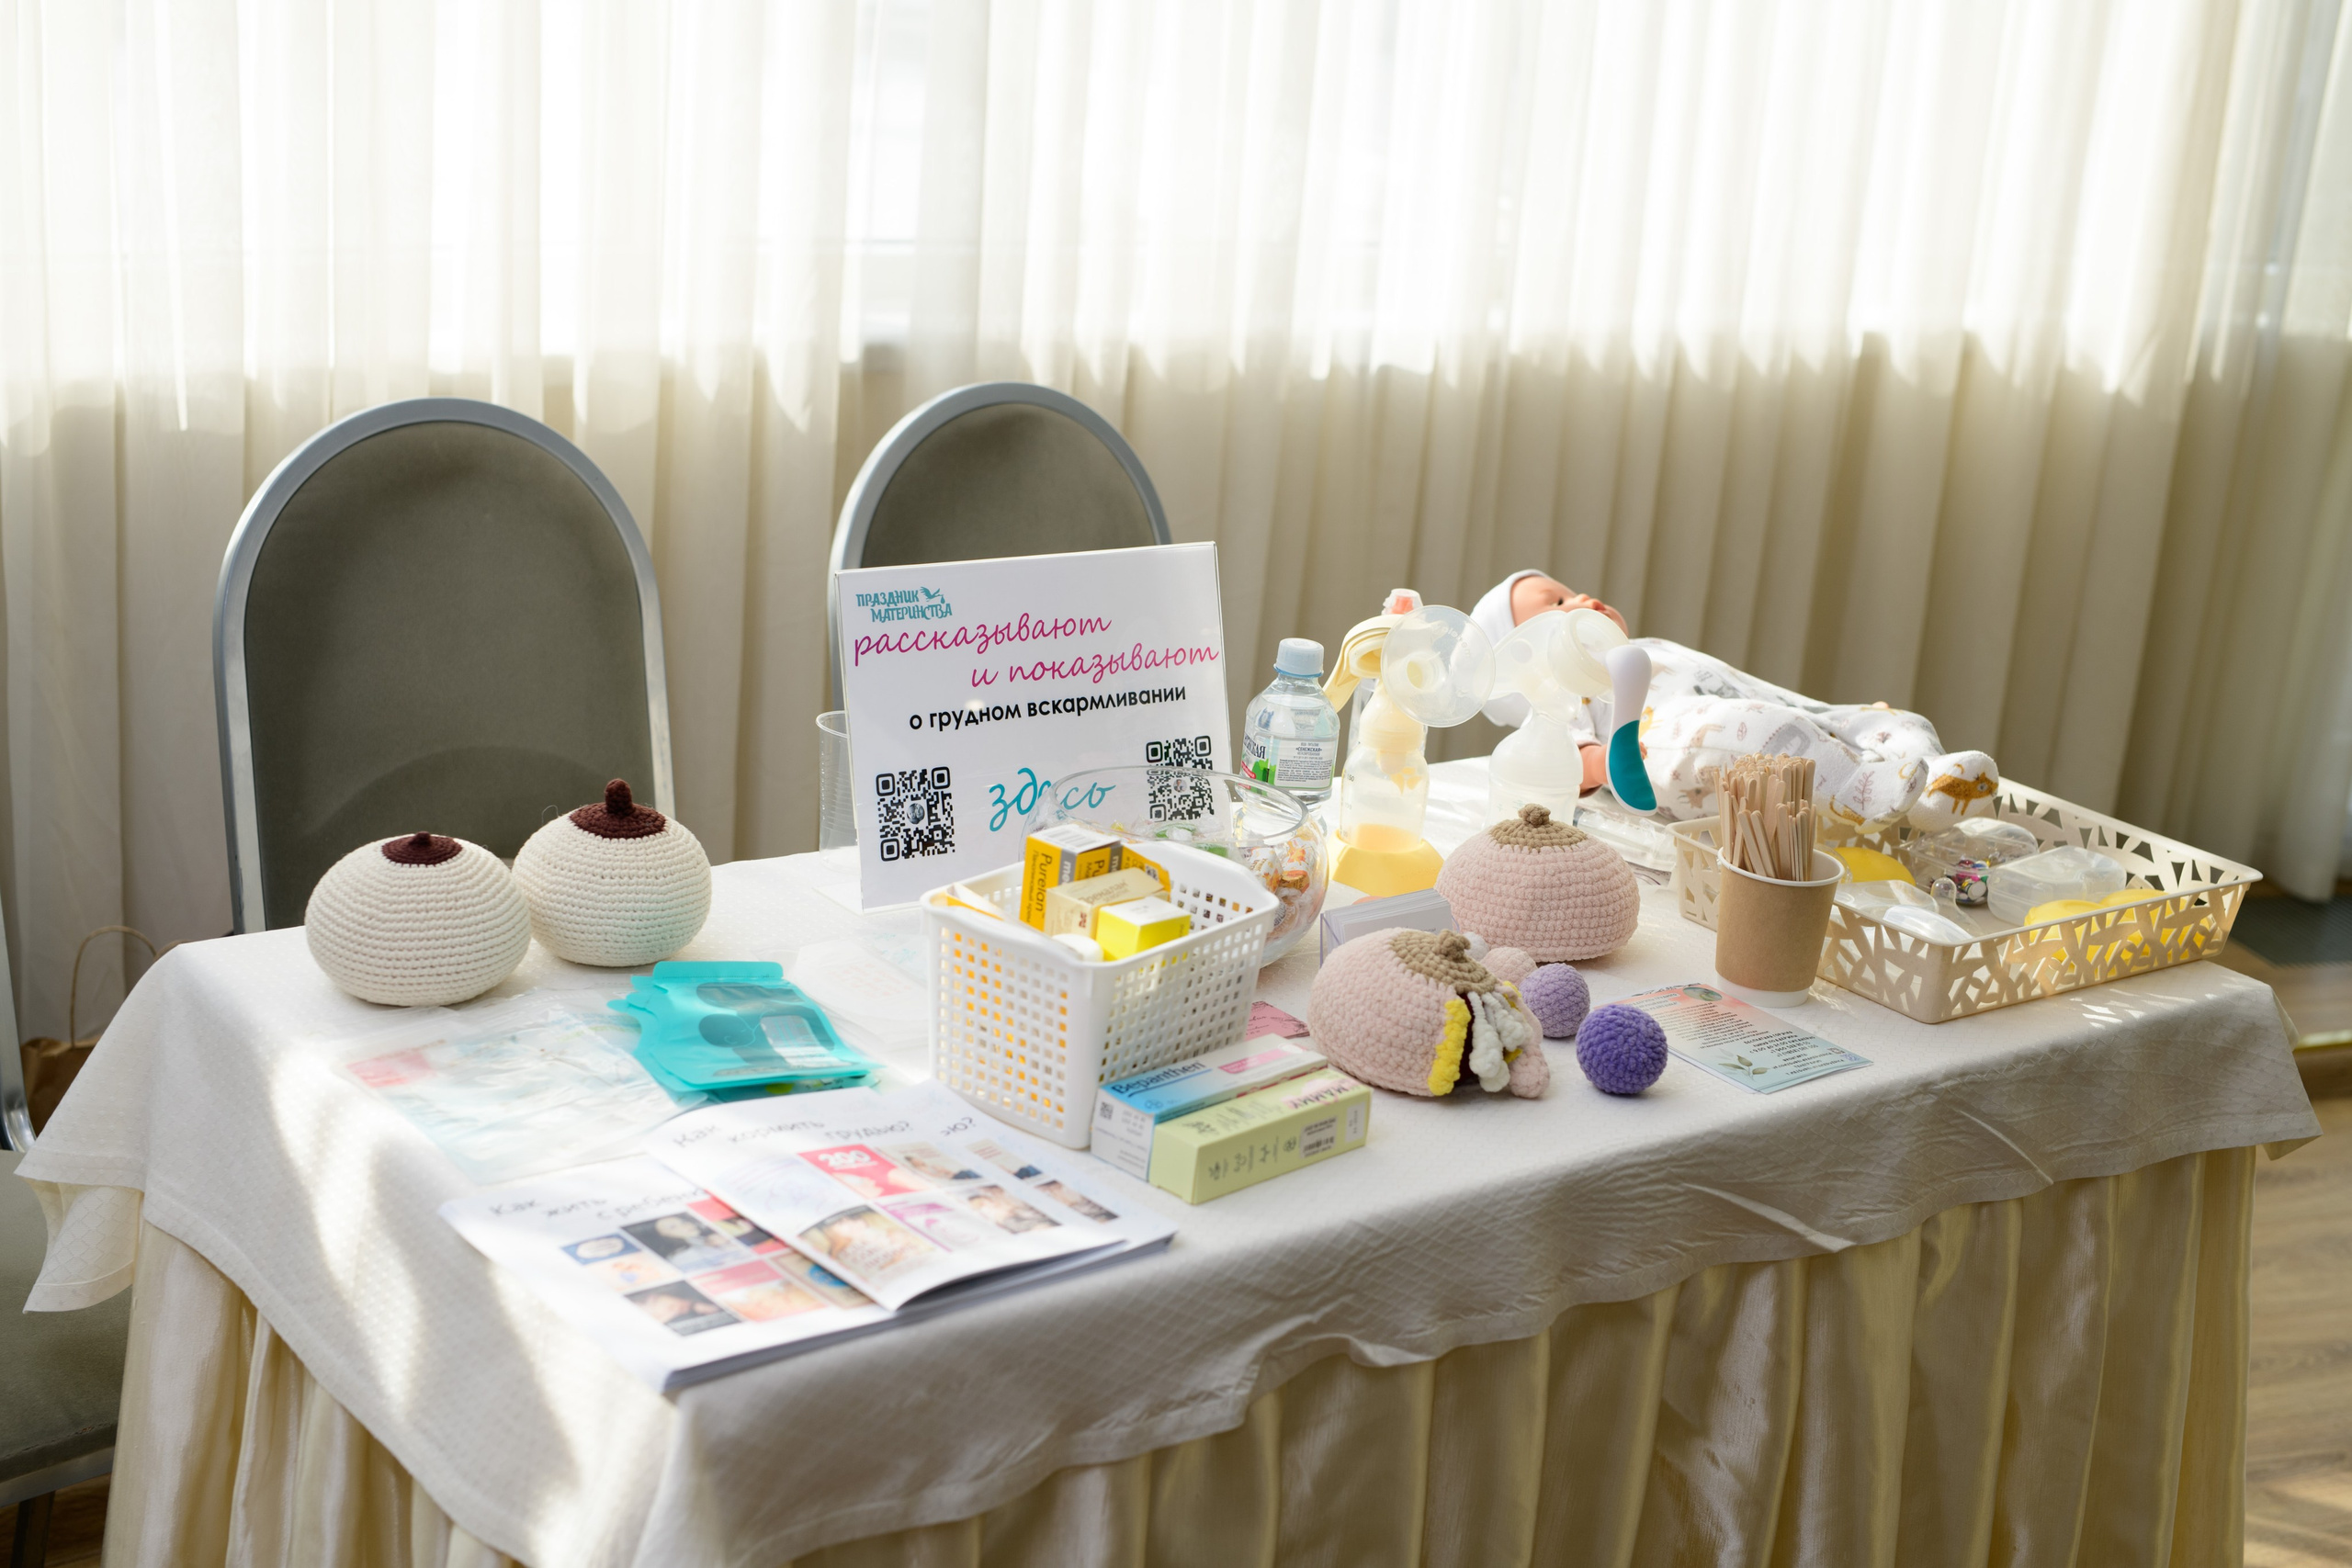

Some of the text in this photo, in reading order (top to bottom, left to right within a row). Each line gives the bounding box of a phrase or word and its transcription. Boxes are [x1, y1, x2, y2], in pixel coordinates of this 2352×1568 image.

[855, 590, 919, 607] ПРАЗДНИК
[870, 604, 953, 623] МАТЕРИНСТВА
[854, 612, 1113, 666] рассказывают
[971, 642, 1220, 687] и показывают
[909, 686, 1186, 731] о грудном вскармливании
[1035, 852, 1053, 912] Purelan
[1111, 1060, 1206, 1095] Bepanthen
